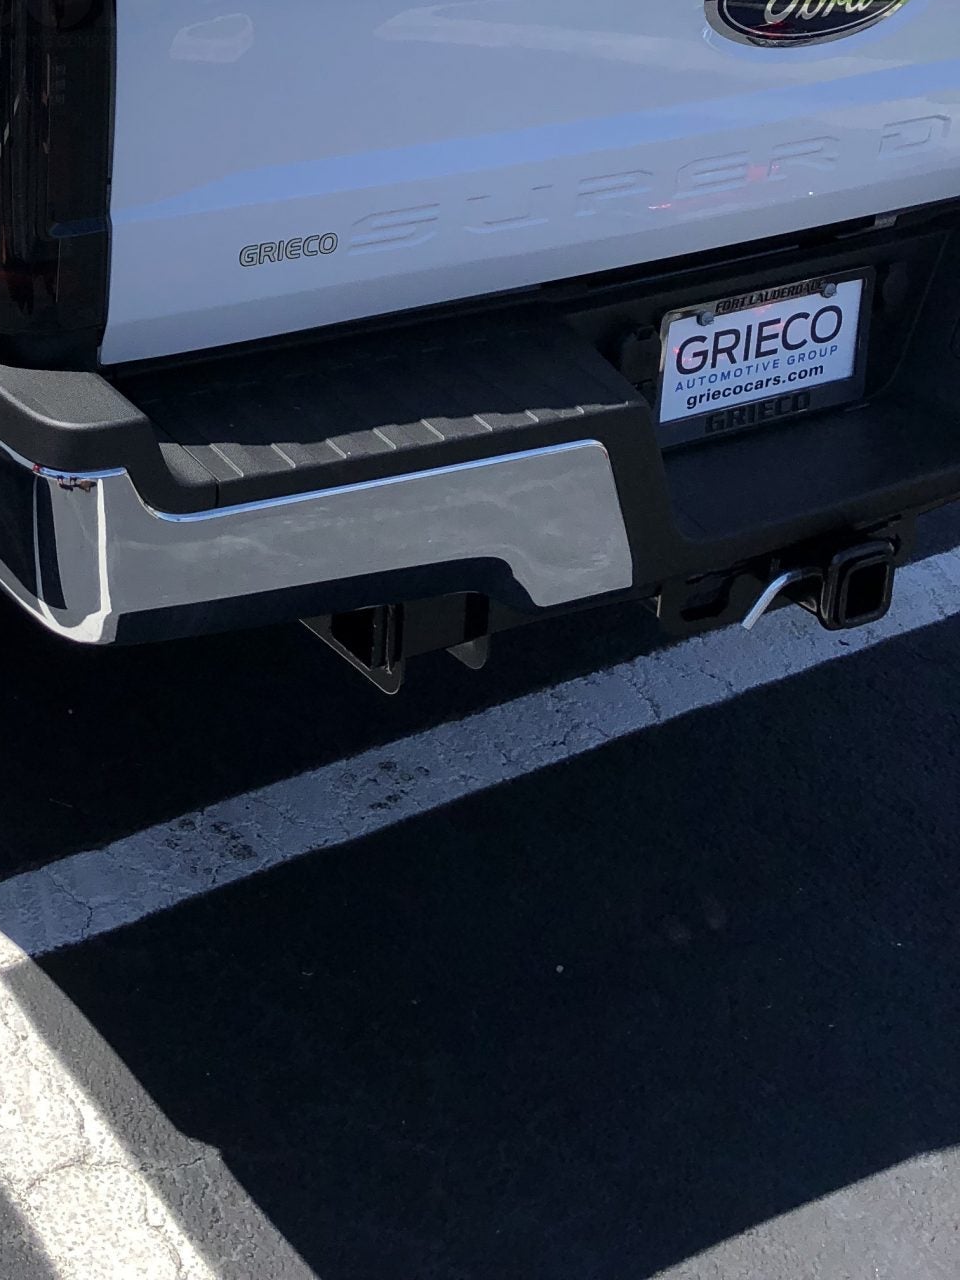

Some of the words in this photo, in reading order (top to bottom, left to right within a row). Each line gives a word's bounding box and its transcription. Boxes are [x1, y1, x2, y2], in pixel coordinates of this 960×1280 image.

[239, 232, 339, 267] GRIECO
[715, 296, 747, 313] FORT
[675, 305, 843, 375] GRIECO
[675, 358, 780, 392] AUTOMOTIVE
[786, 344, 839, 366] GROUP
[686, 365, 824, 410] griecocars.com
[704, 391, 811, 434] GRIECO
